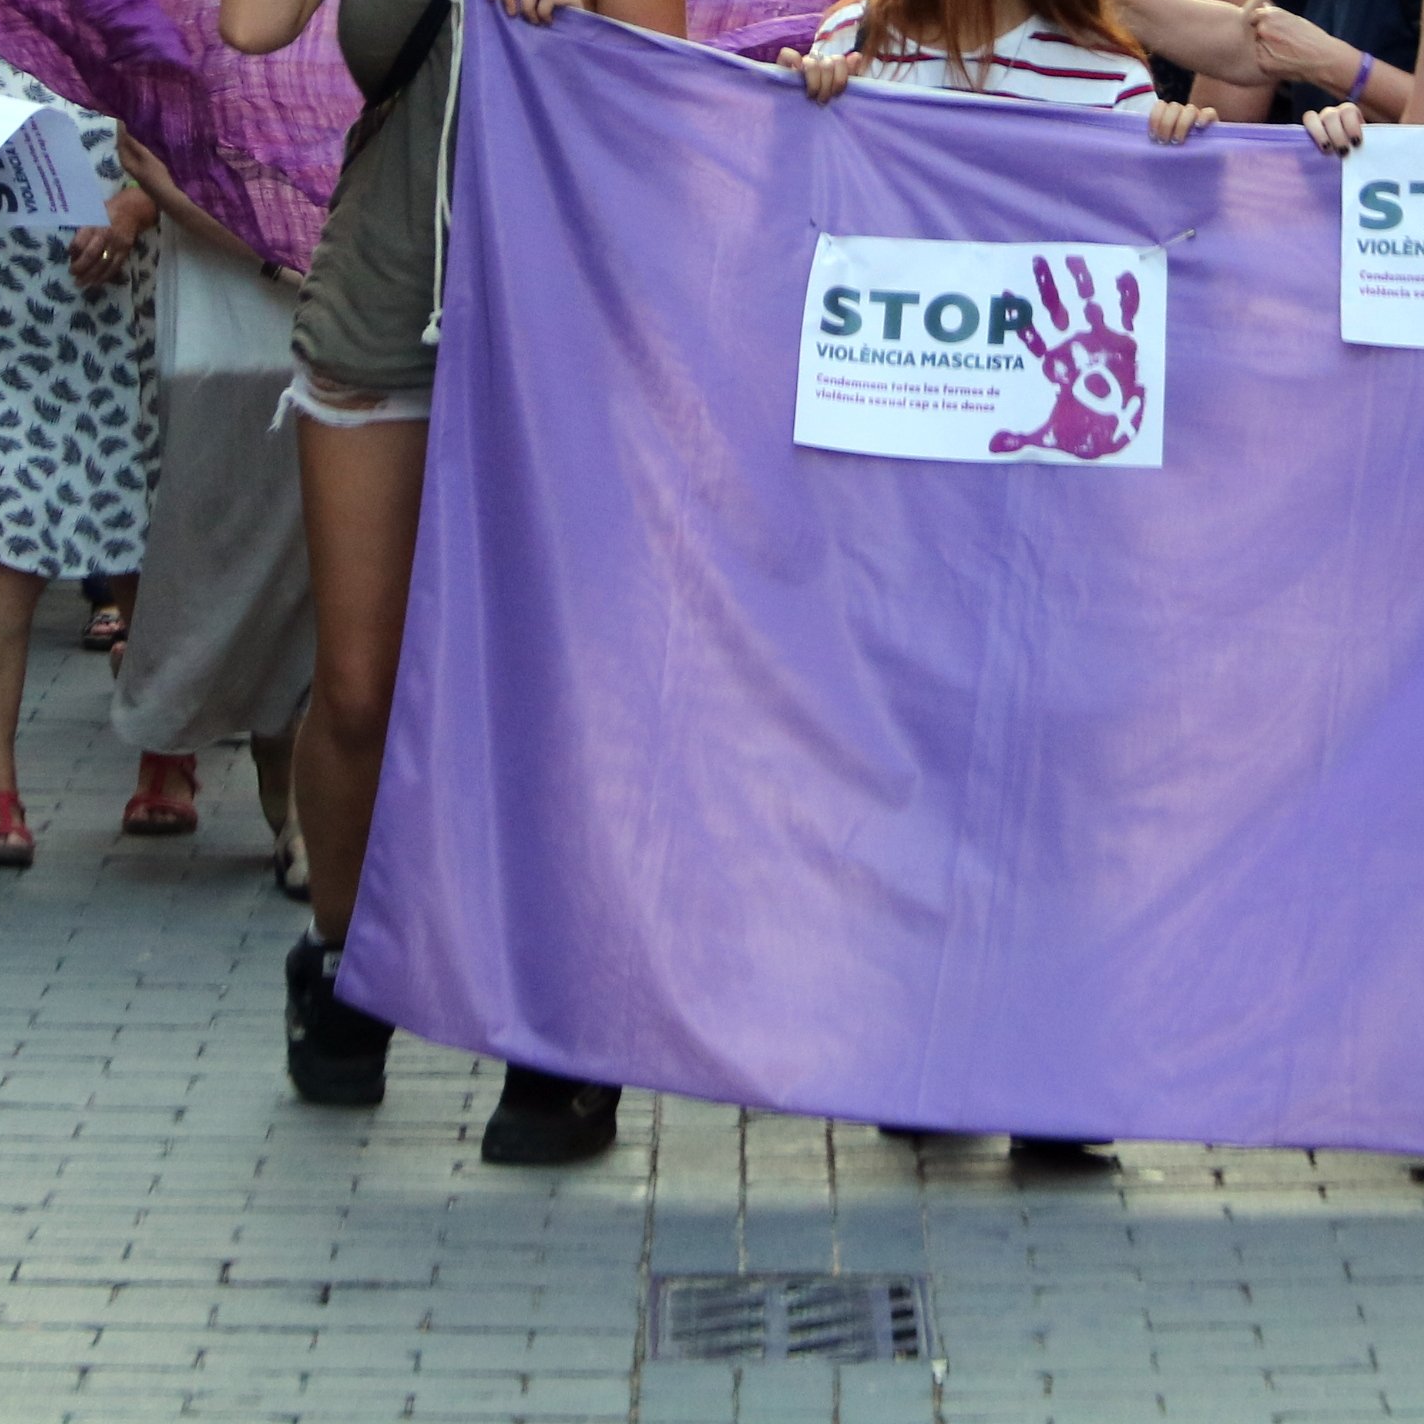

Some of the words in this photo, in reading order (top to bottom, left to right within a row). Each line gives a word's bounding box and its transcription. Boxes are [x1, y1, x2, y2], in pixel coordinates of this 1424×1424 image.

[820, 284, 1033, 345] STOP
[816, 341, 917, 367] VIOLÈNCIA
[920, 350, 1025, 371] MASCLISTA
[816, 372, 888, 392] Condemnem
[891, 381, 921, 393] totes
[869, 395, 907, 409] sexual
[909, 399, 930, 412] cap
